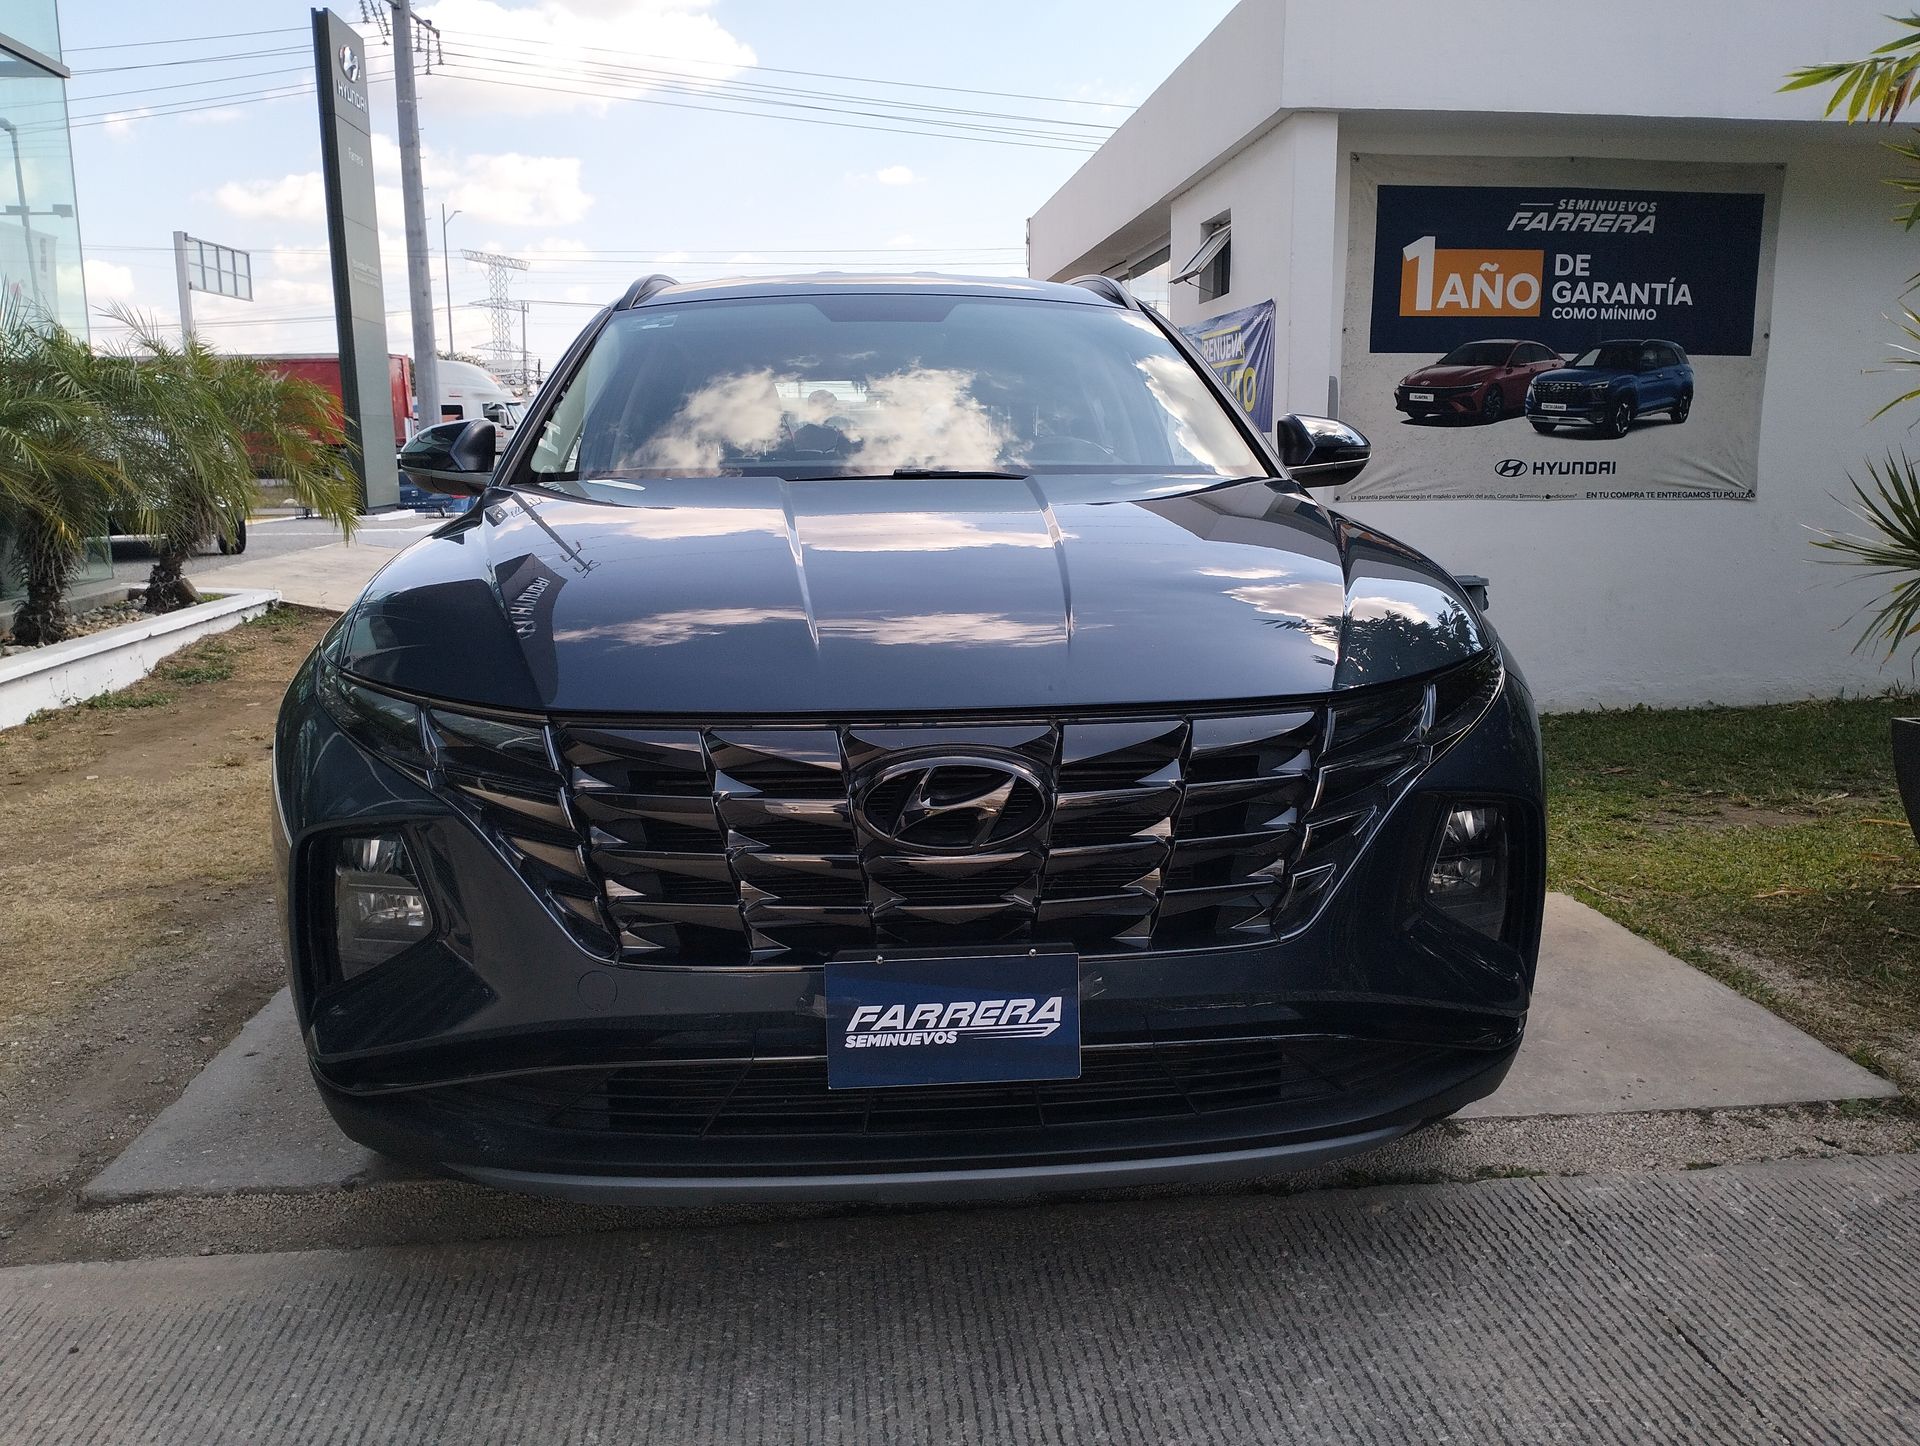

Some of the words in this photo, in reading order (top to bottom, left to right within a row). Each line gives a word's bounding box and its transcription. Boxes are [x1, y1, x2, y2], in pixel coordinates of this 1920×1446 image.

[1557, 199, 1658, 213] SEMINUEVOS
[1507, 212, 1656, 234] FARRERA
[1402, 235, 1436, 311] 1
[1436, 262, 1540, 310] AÑO
[1554, 253, 1591, 277] DE
[1551, 277, 1693, 306] GARANTÍA
[1551, 307, 1598, 320] COMO
[1600, 305, 1657, 321] MÍNIMO
[1222, 367, 1256, 412] UTO
[1532, 461, 1616, 475] HYUNDAI
[1586, 491, 1598, 499] EN
[1599, 491, 1610, 499] TU
[1610, 491, 1644, 499] COMPRA
[1644, 491, 1656, 499] TE
[1657, 491, 1711, 499] ENTREGAMOS
[1711, 491, 1722, 499] TU
[1723, 490, 1750, 500] PÓLIZA
[846, 996, 1063, 1032] FARRERA
[845, 1031, 958, 1049] SEMINUEVOS
